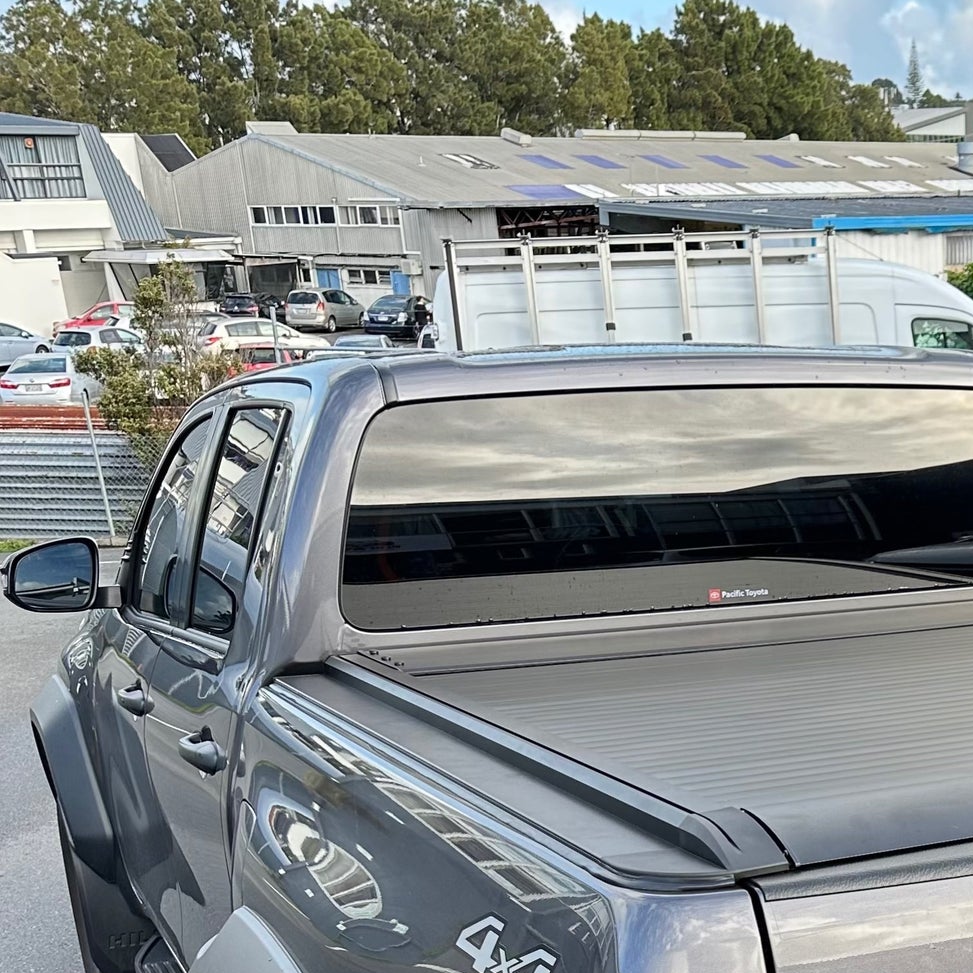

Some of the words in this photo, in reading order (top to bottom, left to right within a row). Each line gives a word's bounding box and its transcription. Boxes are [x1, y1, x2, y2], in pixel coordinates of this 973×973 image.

[721, 589, 745, 599] Pacific
[745, 588, 769, 598] Toyota
[109, 930, 156, 949] HIL
